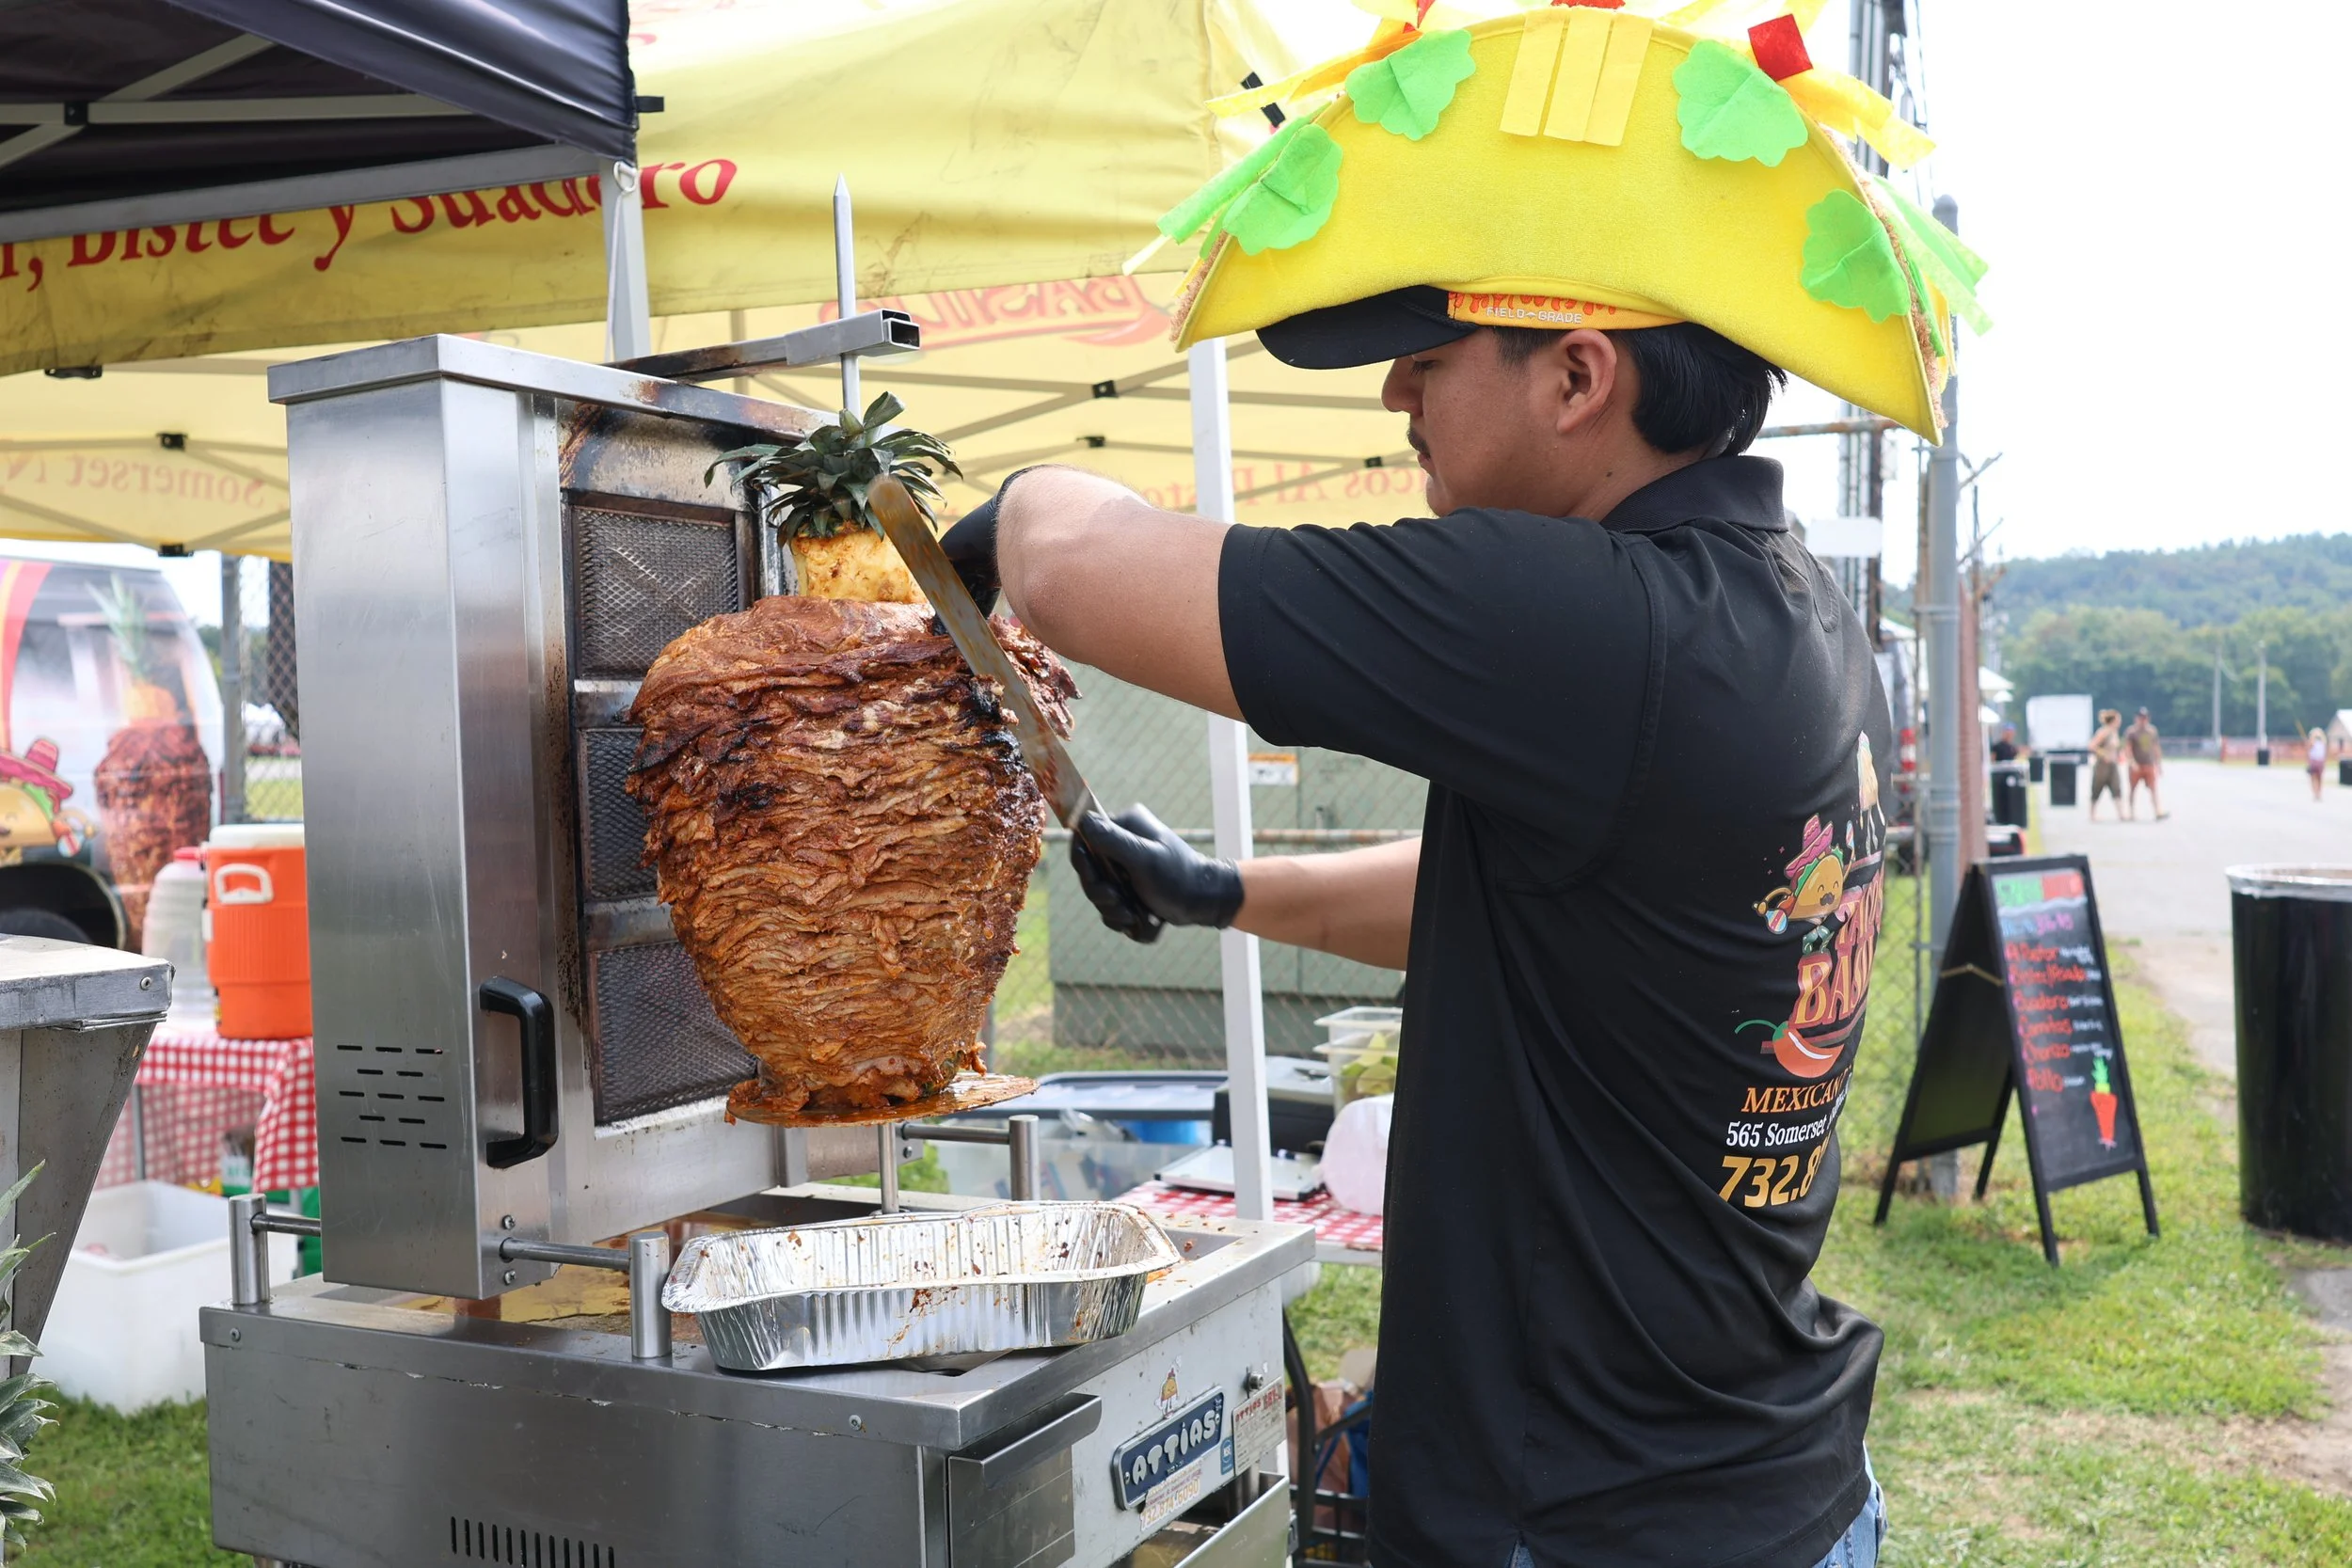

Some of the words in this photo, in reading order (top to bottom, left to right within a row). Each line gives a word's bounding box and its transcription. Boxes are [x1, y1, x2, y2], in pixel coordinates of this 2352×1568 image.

[390, 159, 737, 233] Suadro
[1486, 307, 1525, 319] FIELD
[1538, 310, 1582, 324] GRADE
[1740, 1079, 1840, 1114] MEXICAN
[1726, 1120, 1764, 1148] 565
[1765, 1115, 1827, 1148] Somerset
[1718, 1134, 1830, 1209] 732.8
